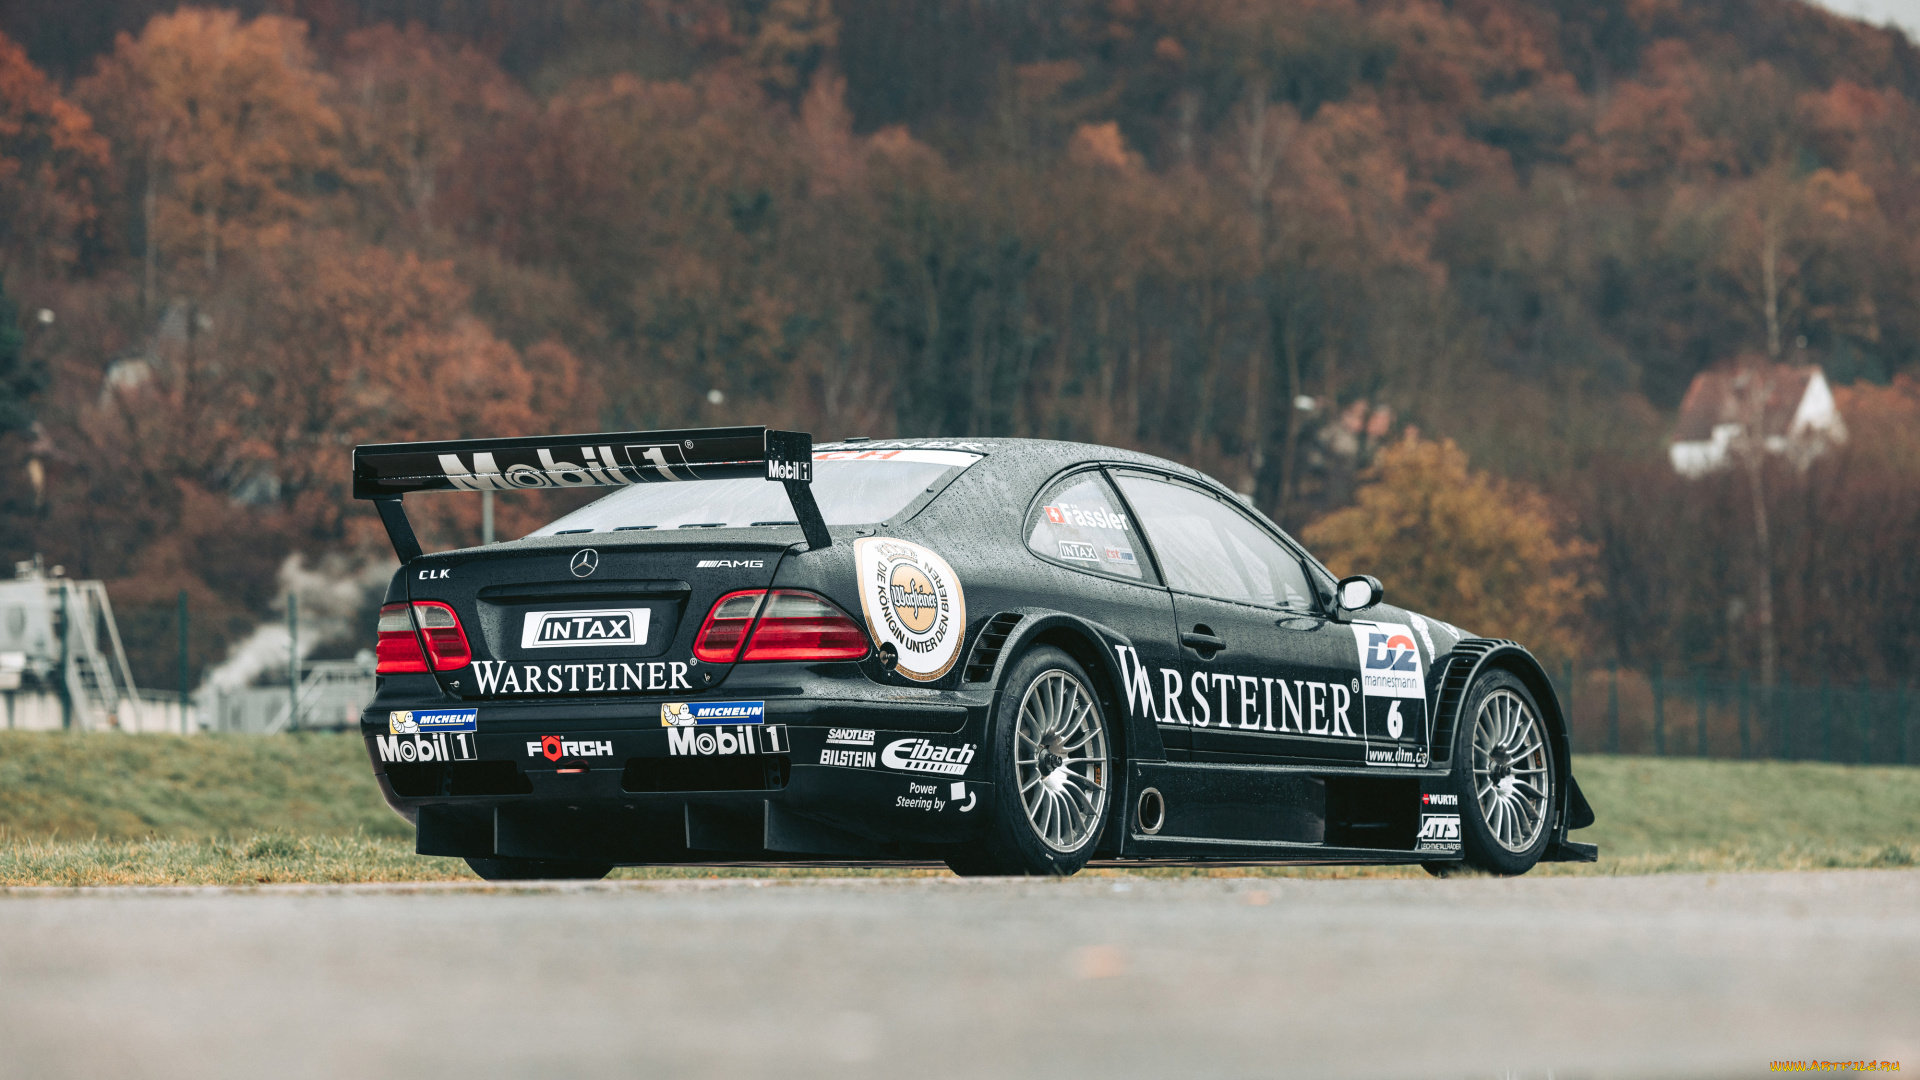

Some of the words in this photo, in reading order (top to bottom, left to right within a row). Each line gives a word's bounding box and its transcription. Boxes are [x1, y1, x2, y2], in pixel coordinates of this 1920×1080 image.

[437, 446, 635, 491] Mobil
[768, 460, 800, 480] Mobil
[1058, 503, 1129, 531] Fässler
[419, 568, 451, 580] CLK
[716, 559, 764, 569] AMG
[877, 561, 887, 585] DIE
[924, 562, 949, 613] BIEREN
[877, 585, 906, 645] KÖNIGIN
[544, 617, 628, 640] INTAX
[937, 616, 950, 643] DEN
[905, 639, 938, 654] UNTER
[1365, 632, 1417, 672] D2
[471, 660, 693, 695] WARSTEINER
[1364, 674, 1418, 689] mannesmann
[419, 713, 476, 725] MICHELIN
[697, 706, 763, 717] MICHELIN
[1387, 700, 1404, 739] 6
[667, 725, 756, 756] Mobil
[828, 728, 876, 741] SANDTLER
[376, 733, 450, 762] Mobil
[819, 749, 877, 768] BILSTEIN
[881, 738, 976, 776] Eibach
[909, 782, 938, 795] Power
[895, 795, 933, 812] Steering
[934, 797, 946, 812] by
[1416, 817, 1461, 838] ATS
